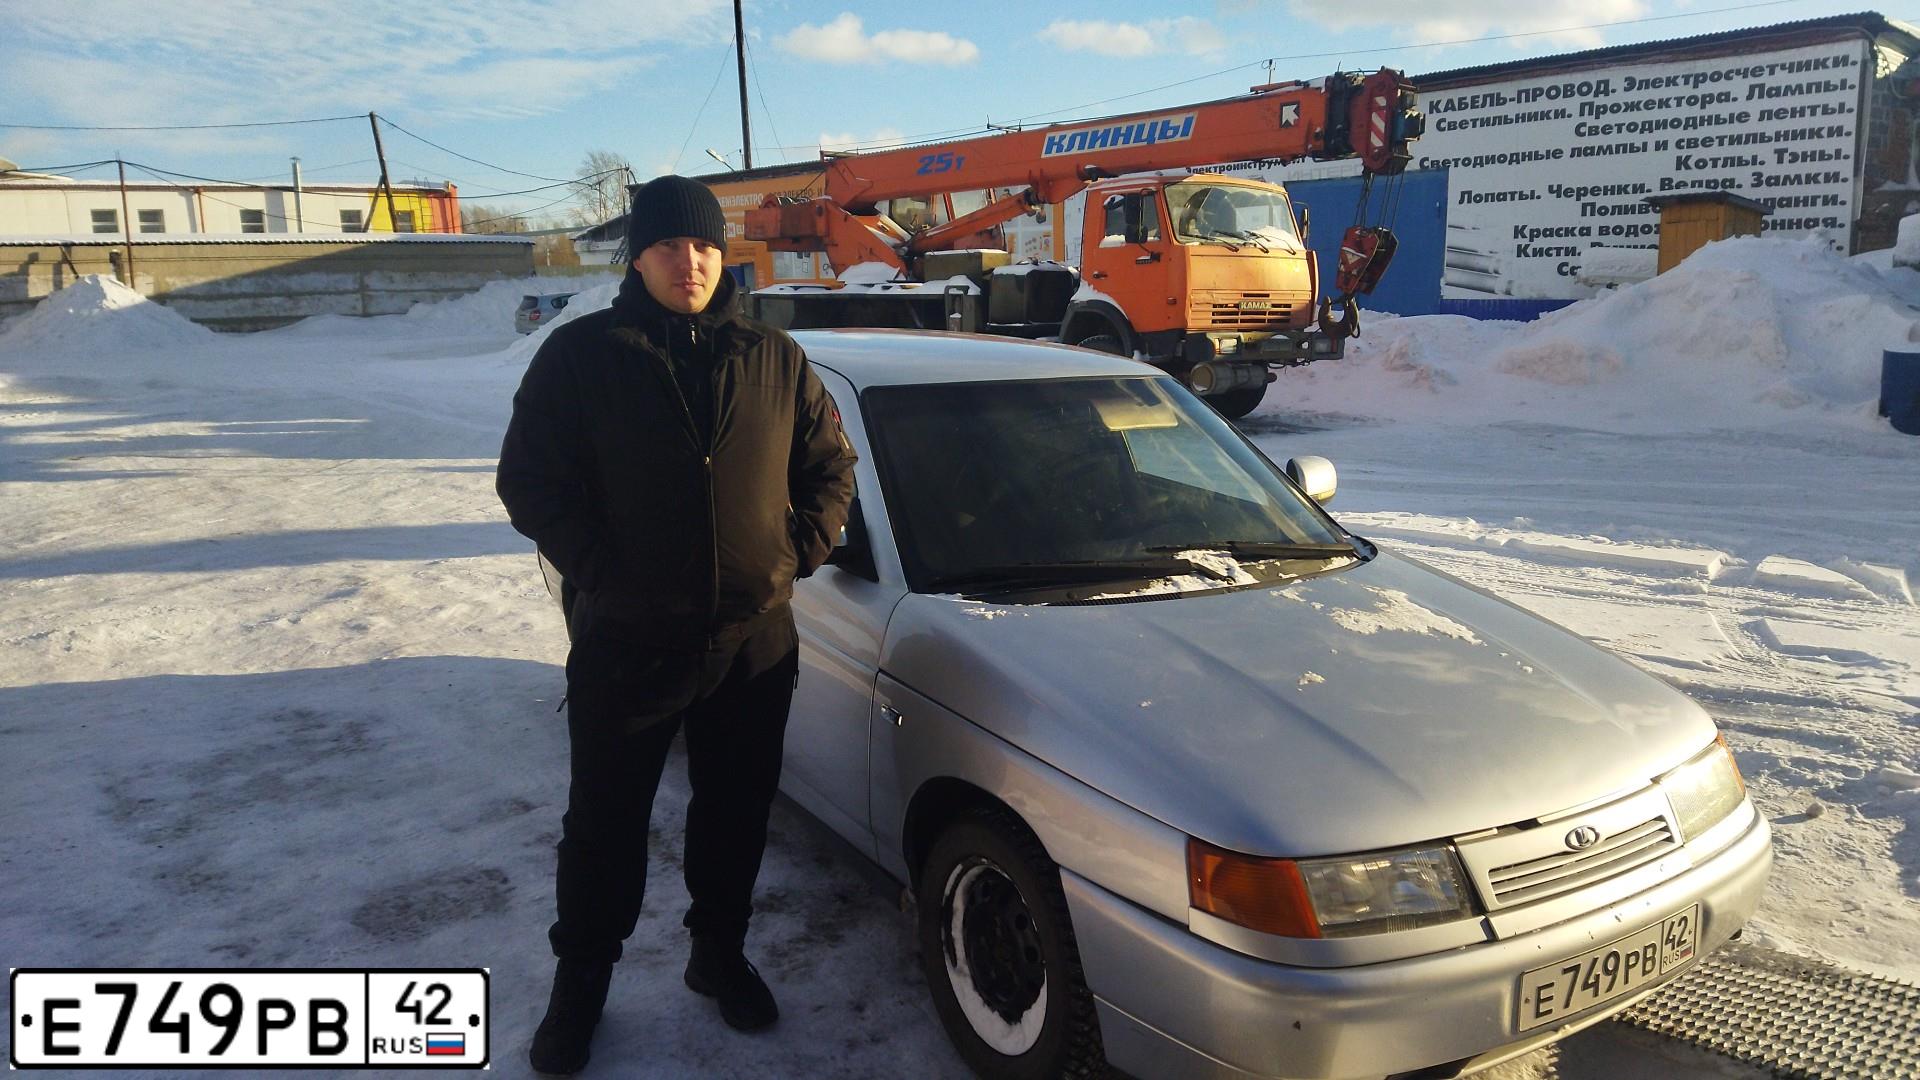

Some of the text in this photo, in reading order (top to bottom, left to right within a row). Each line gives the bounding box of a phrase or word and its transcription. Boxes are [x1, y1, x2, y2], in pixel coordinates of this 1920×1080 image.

[1428, 54, 1858, 114] КАБЕЛЬ-ПРОВОД. Электросчетчики.
[1436, 78, 1856, 132] Светильники. Прожектора. Лампы.
[1574, 102, 1855, 138] Светодиодные ленты.
[1418, 125, 1853, 170] Светодиодные лампы и светильники.
[1675, 147, 1850, 171] Котлы. Тэны.
[1458, 189, 1541, 205] Лопаты.
[1548, 182, 1652, 201] Черенки.
[1751, 171, 1849, 188] Замки.
[1513, 224, 1592, 242] Краска
[1665, 915, 1688, 951] 42
[1662, 952, 1680, 967] RUS
